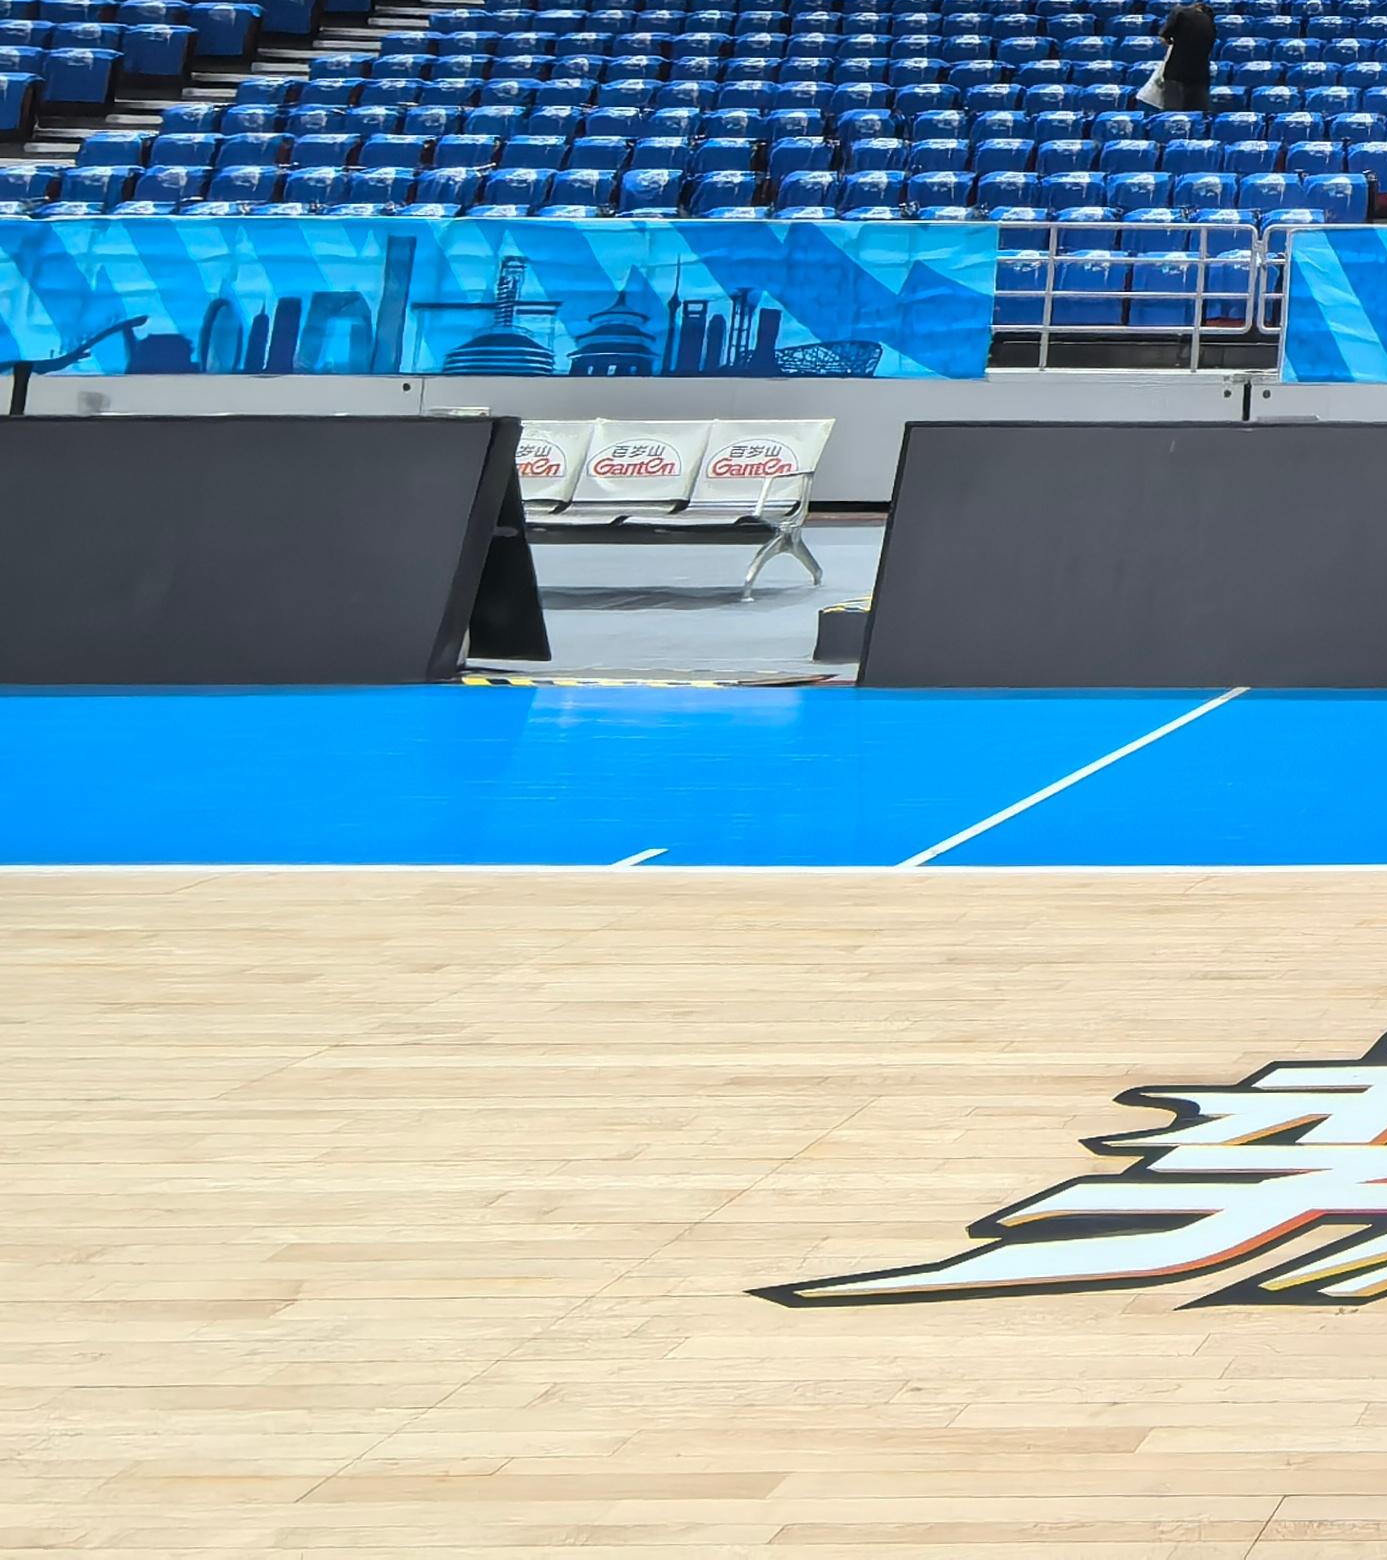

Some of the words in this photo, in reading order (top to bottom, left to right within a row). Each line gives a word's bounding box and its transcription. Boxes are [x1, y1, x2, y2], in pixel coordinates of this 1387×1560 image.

[515, 444, 552, 458] 岁山
[611, 444, 666, 458] 百岁山
[729, 444, 783, 459] 百岁山
